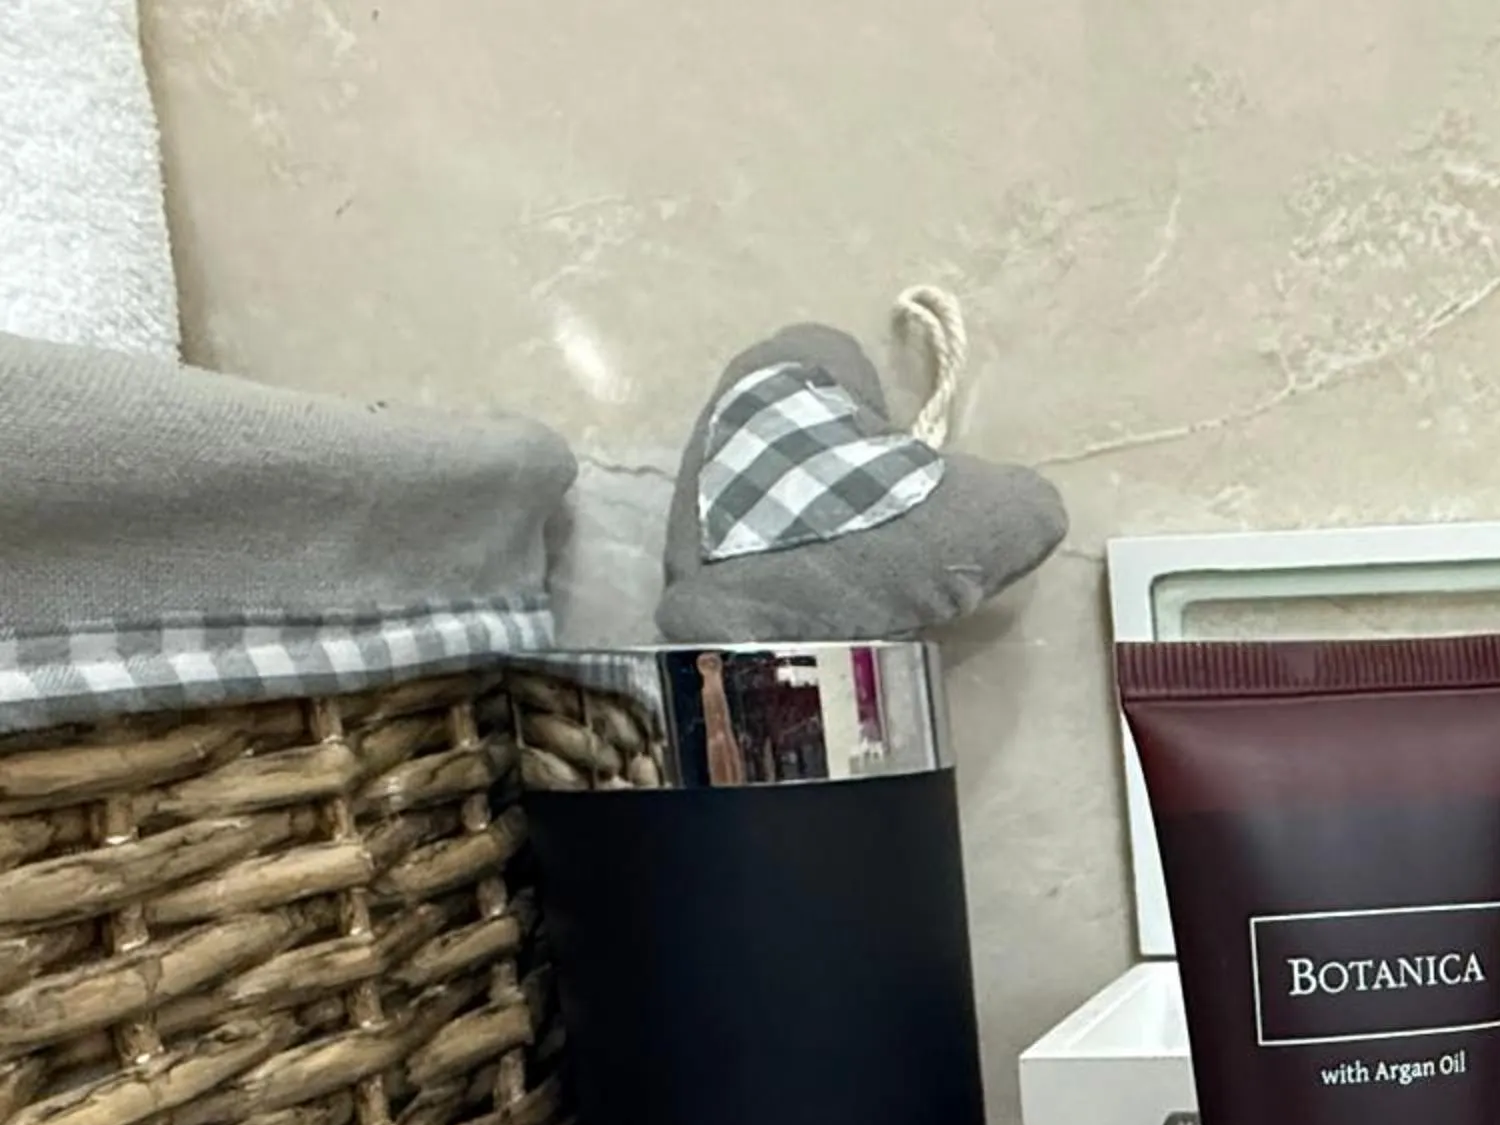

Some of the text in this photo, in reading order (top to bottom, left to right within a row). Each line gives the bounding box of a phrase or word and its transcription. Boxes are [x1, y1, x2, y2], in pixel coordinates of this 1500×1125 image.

[1286, 952, 1485, 996] BOTANICA
[1321, 1050, 1466, 1085] with Argan Oil
